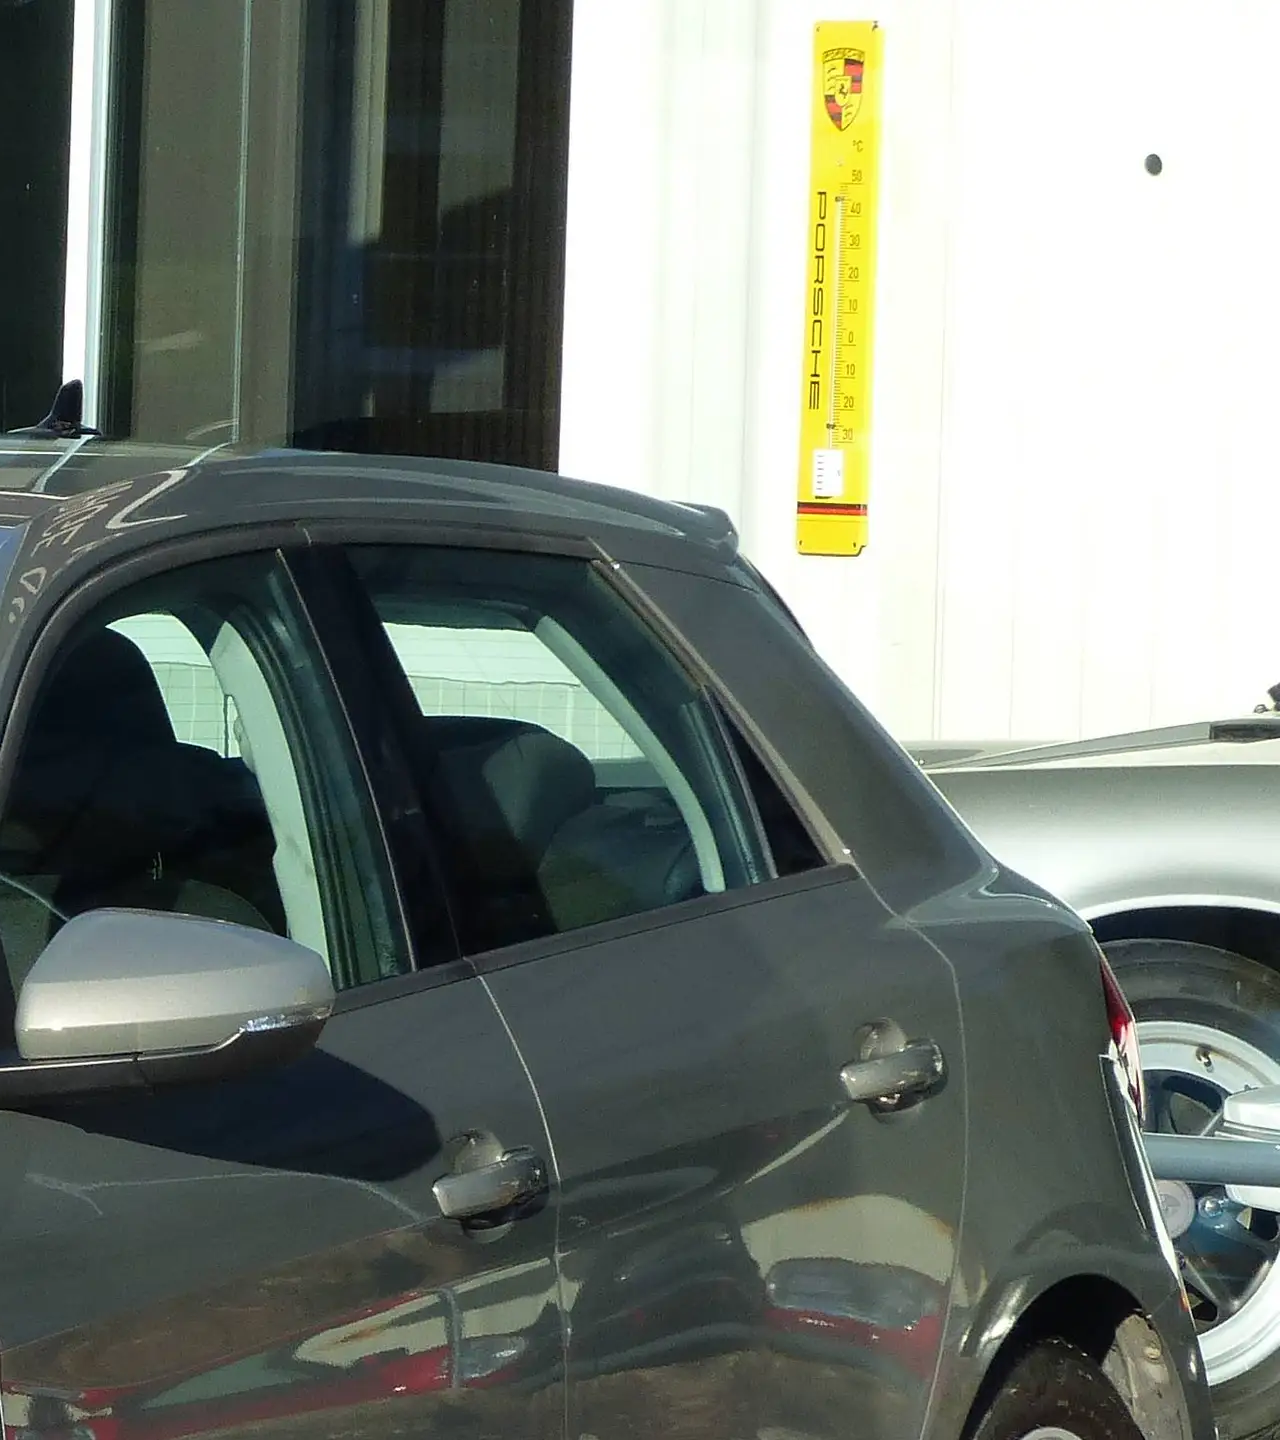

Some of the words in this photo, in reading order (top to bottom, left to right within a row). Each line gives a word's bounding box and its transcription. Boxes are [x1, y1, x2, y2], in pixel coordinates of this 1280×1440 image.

[851, 169, 863, 183] 50
[850, 202, 862, 215] 40
[849, 234, 860, 247] 30
[848, 266, 859, 280] 20
[808, 191, 828, 410] PORSCHE
[848, 299, 858, 312] 10
[847, 331, 854, 344] 0
[845, 363, 856, 376] 10
[843, 396, 855, 409] 20
[842, 428, 853, 441] 30
